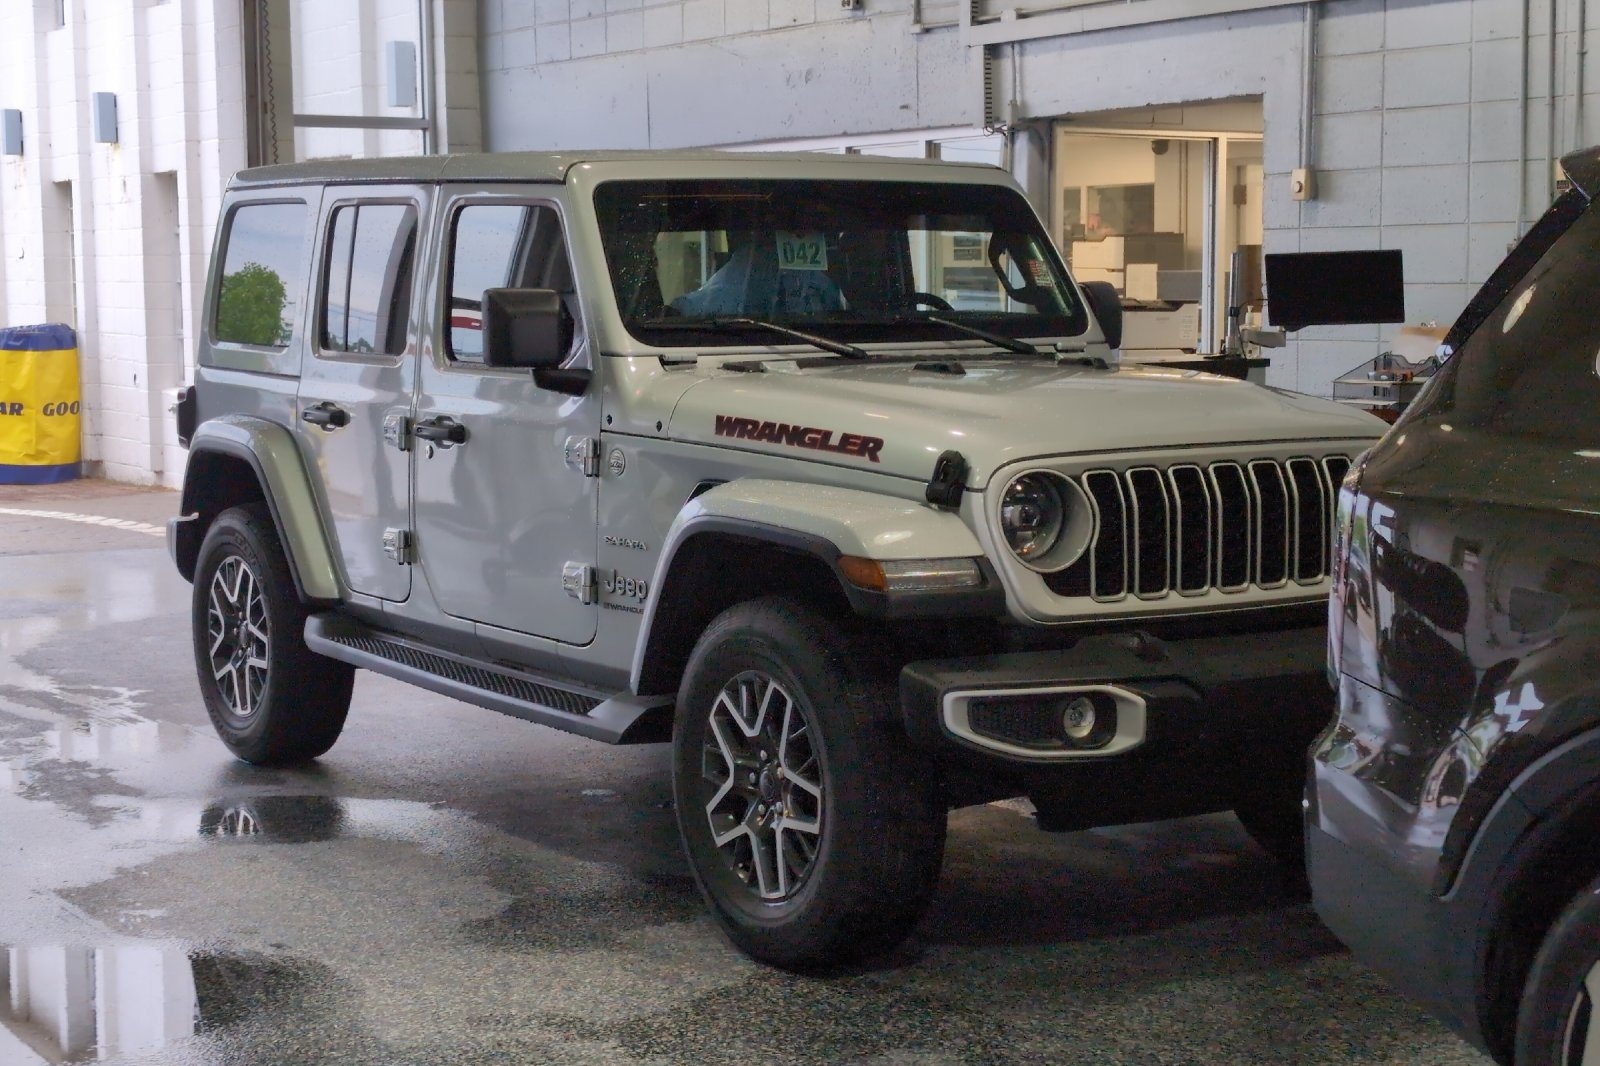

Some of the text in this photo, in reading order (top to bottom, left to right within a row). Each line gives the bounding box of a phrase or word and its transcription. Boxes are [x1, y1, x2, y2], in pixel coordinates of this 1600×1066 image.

[783, 240, 821, 265] 042
[715, 415, 884, 463] WRANGLER
[604, 569, 648, 604] Jeep
[609, 603, 645, 614] WRANGLE
